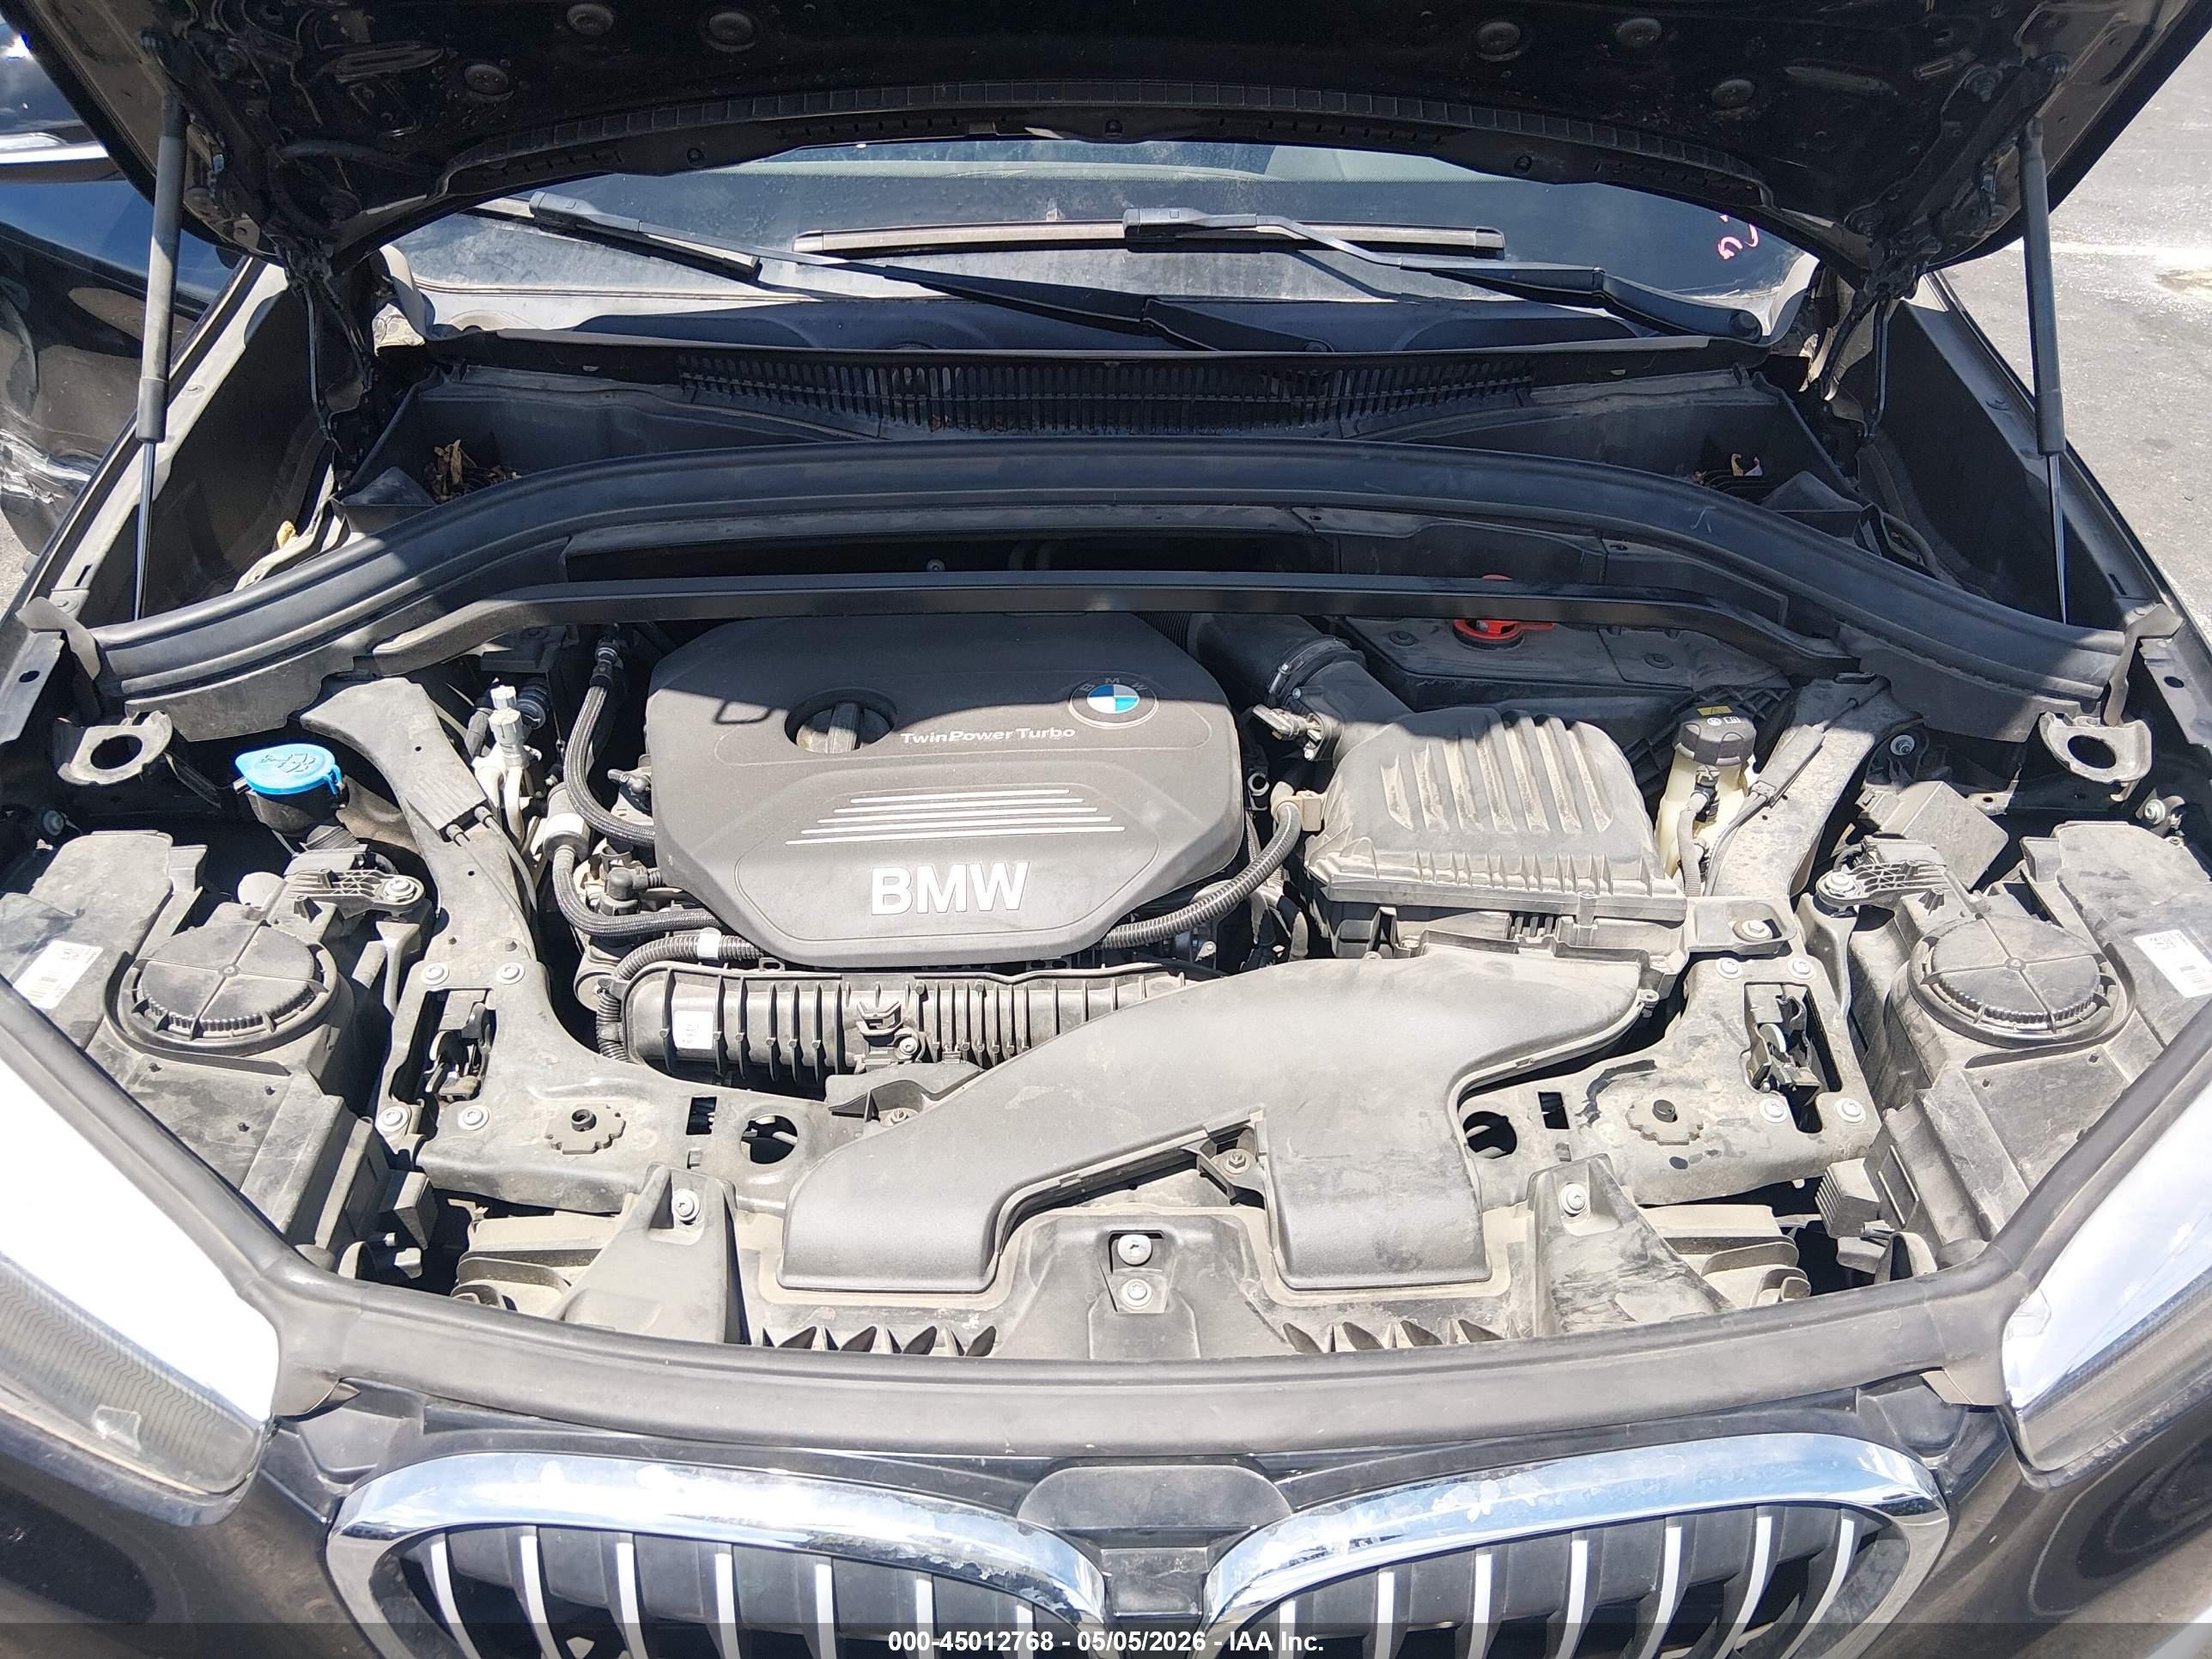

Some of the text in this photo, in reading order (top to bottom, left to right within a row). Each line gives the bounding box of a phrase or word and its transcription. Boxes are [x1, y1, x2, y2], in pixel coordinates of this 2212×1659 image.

[1079, 677, 1148, 692] BMW
[900, 726, 1076, 744] TwinPower Turbo
[871, 861, 1030, 916] BMW
